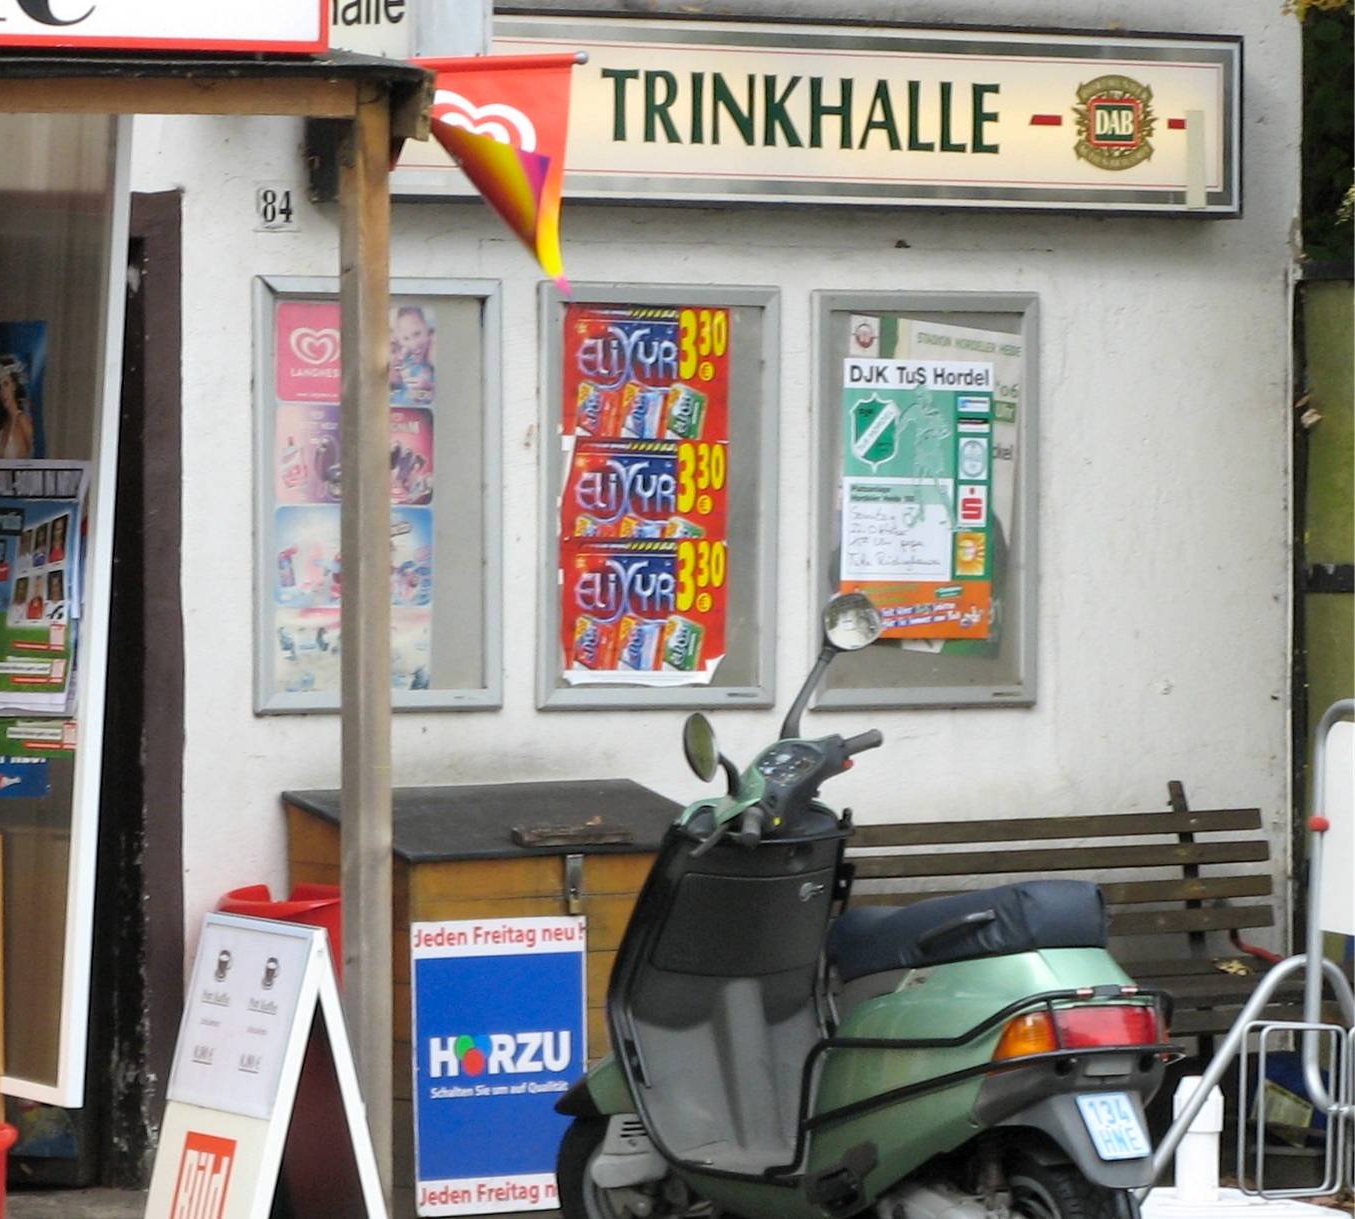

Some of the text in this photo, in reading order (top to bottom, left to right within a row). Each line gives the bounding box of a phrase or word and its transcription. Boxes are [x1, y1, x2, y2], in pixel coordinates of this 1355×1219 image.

[601, 66, 1001, 155] TRINKHALLE
[1094, 108, 1134, 135] DAB
[262, 188, 294, 224] 84
[849, 365, 989, 386] DJK TuS Hordel
[414, 927, 468, 948] Jeden
[473, 925, 536, 947] Freitag
[431, 1087, 474, 1099] Schalten
[475, 1085, 490, 1096] Sie
[1088, 1097, 1130, 1125] 134
[1098, 1126, 1143, 1154] HNE
[420, 1185, 471, 1207] Jeden
[477, 1182, 539, 1204] Freitag
